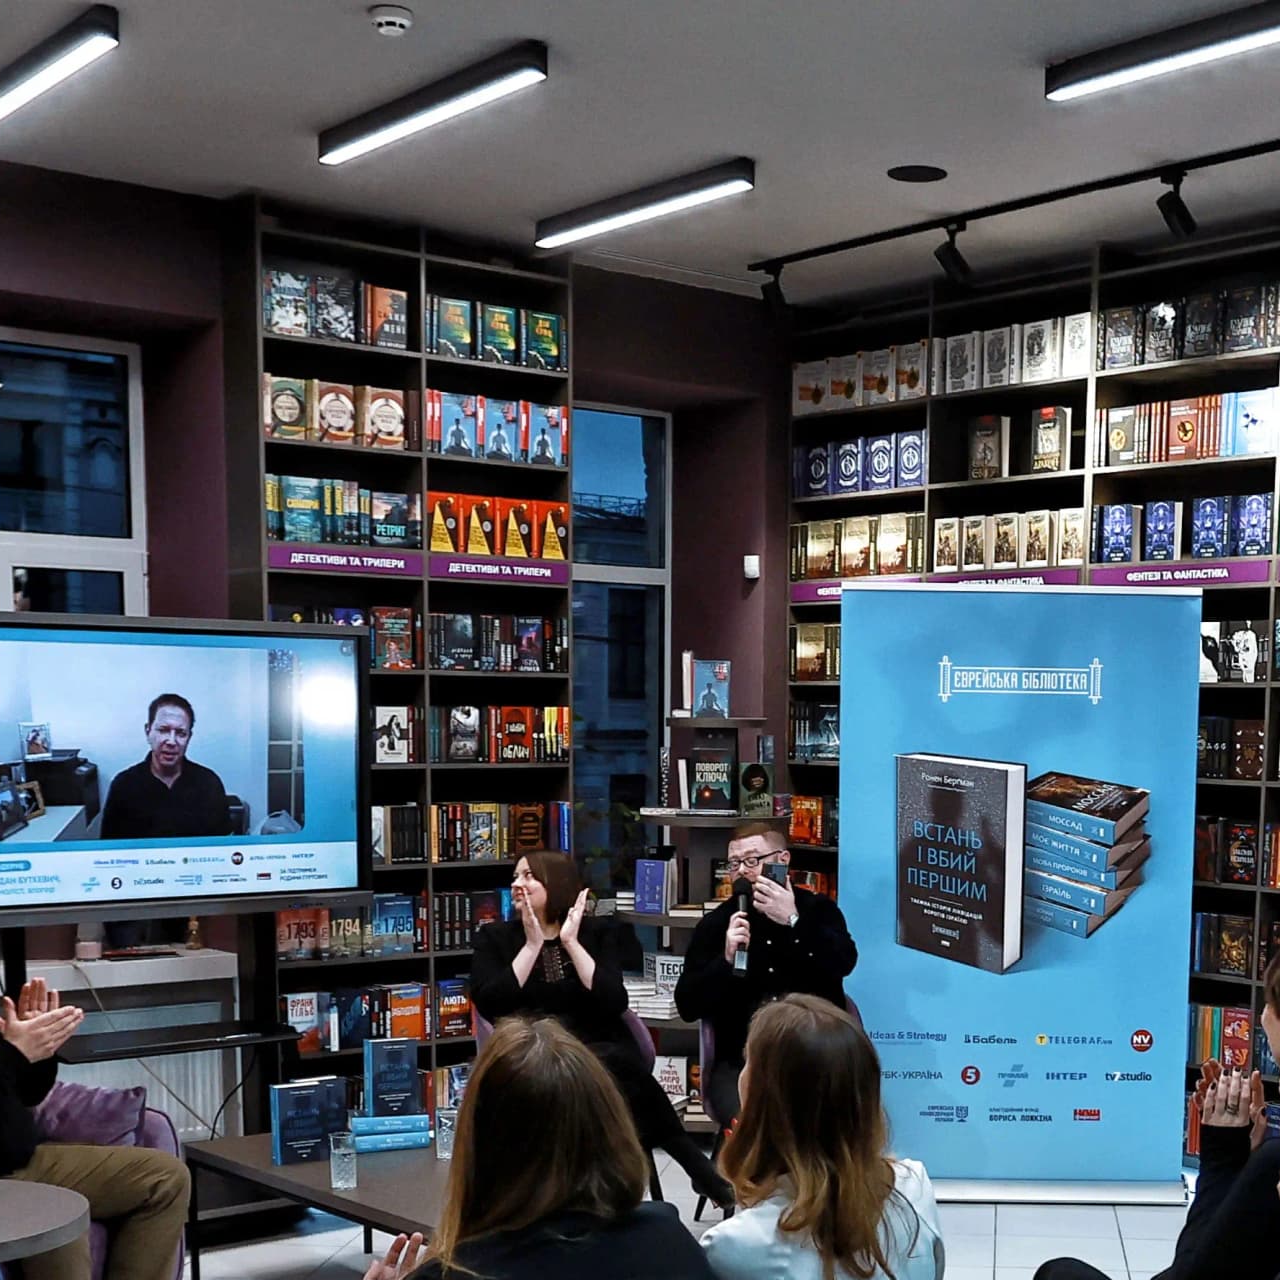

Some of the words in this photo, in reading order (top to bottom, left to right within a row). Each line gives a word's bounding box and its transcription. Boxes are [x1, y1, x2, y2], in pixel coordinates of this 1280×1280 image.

[376, 523, 407, 536] РЕТРИТ
[290, 552, 347, 566] ДЕТЕКТИВИ
[349, 556, 362, 567] ТА
[362, 557, 405, 569] ТРИЛЕРИ
[448, 562, 499, 575] ДЕТЕКТИВИ
[501, 565, 512, 576] ТА
[513, 566, 552, 577] ТРИЛЕРИ
[1126, 570, 1161, 583] ФЕНТЕЗІ
[1162, 569, 1173, 581] ТА
[1173, 567, 1229, 580] ФАНТАСТИКА
[954, 669, 1018, 690] ЄВРЕЙСЬКА
[1021, 670, 1088, 691] БІБЛІОТЕКА
[695, 763, 729, 772] ПОВОРОТ
[695, 772, 729, 783] КЛЮЧА
[921, 771, 943, 785] Ронен
[1072, 784, 1120, 811] МОССАД
[1048, 813, 1083, 832] МОССАД
[913, 820, 983, 849] ВСТАНЬ
[1031, 833, 1050, 847] МОЄ
[1051, 837, 1081, 856] ЖИТТЯ
[917, 846, 922, 863] І
[927, 844, 976, 875] ВБИЙ
[1052, 861, 1088, 877] ПРОРОКІВ
[907, 870, 988, 902] ПЕРШИМ
[1041, 883, 1072, 900] ІЗРАЇЛЬ
[286, 921, 317, 940] 1793
[330, 918, 361, 937] 1794
[384, 915, 413, 934] 1795
[443, 996, 467, 1006] ЛЮТЬ
[870, 1030, 896, 1041] Ideas
[897, 1031, 905, 1039] &
[906, 1031, 947, 1042] Strategy
[972, 1034, 1018, 1045] Бабель
[1133, 1034, 1151, 1044] NV
[966, 1069, 976, 1081] 5
[1046, 1072, 1088, 1081] ІНТЕР
[989, 1114, 1017, 1122] БОРИСА
[1020, 1114, 1053, 1122] ЛОЖКІНА
